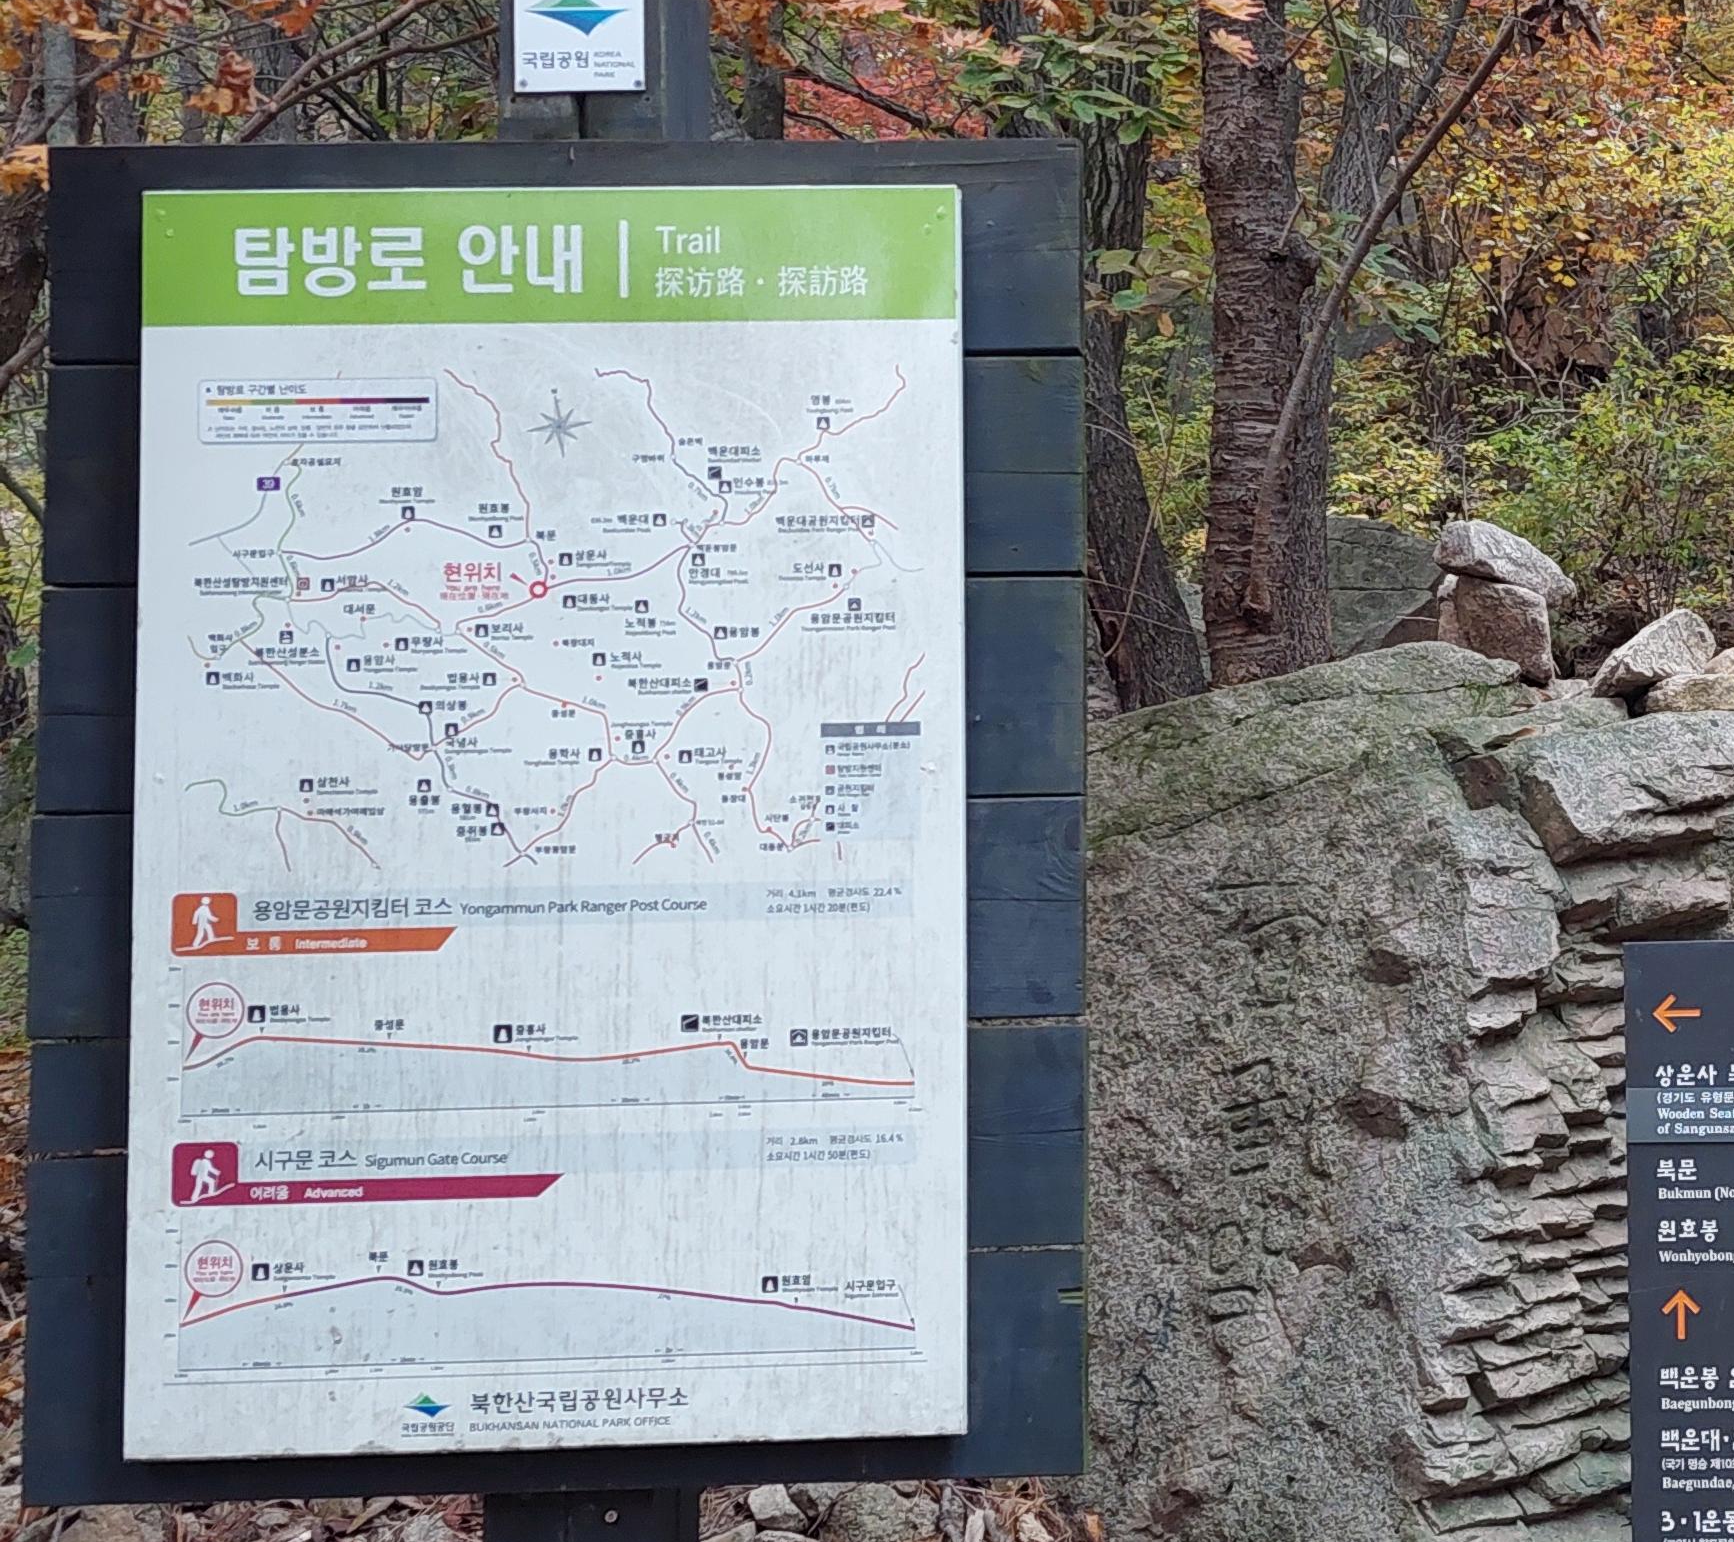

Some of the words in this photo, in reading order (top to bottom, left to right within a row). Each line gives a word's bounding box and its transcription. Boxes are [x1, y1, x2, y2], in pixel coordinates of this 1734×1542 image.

[522, 51, 589, 69] 국립공원
[656, 226, 722, 254] Trail
[234, 225, 428, 295] 탐방로
[457, 224, 585, 294] 안내
[443, 562, 501, 582] 현위치
[254, 898, 409, 921] 용암문공원지킴터
[414, 897, 452, 916] 코스
[460, 903, 544, 916] Yongammun
[547, 901, 578, 913] Park
[581, 900, 627, 916] Ranger
[630, 900, 659, 912] Post
[661, 899, 707, 911] Course
[295, 937, 368, 950] Intermediate
[199, 999, 234, 1011] 현위치
[1655, 1064, 1717, 1087] 상운사
[1657, 1093, 1695, 1104] (경기도
[1658, 1108, 1704, 1119] Wooden
[1657, 1124, 1670, 1134] of
[255, 1150, 313, 1171] 시구문
[318, 1150, 358, 1168] 코스
[365, 1153, 424, 1170] Sigumun
[427, 1153, 458, 1166] Gate
[462, 1152, 508, 1165] Course
[1657, 1159, 1697, 1181] 북문
[250, 1186, 289, 1200] 어려움
[304, 1185, 363, 1198] Advanced
[1658, 1188, 1711, 1199] Bukmun
[1658, 1219, 1718, 1243] 원효봉
[1660, 1367, 1719, 1390] 백운봉
[469, 1388, 689, 1415] 북한산국립공원사무소
[469, 1420, 539, 1432] BUKHANSAN
[543, 1418, 598, 1430] NATIONAL
[602, 1417, 630, 1428] PARK
[634, 1416, 671, 1426] OFFICE
[1663, 1477, 1734, 1491] Baegundae,
